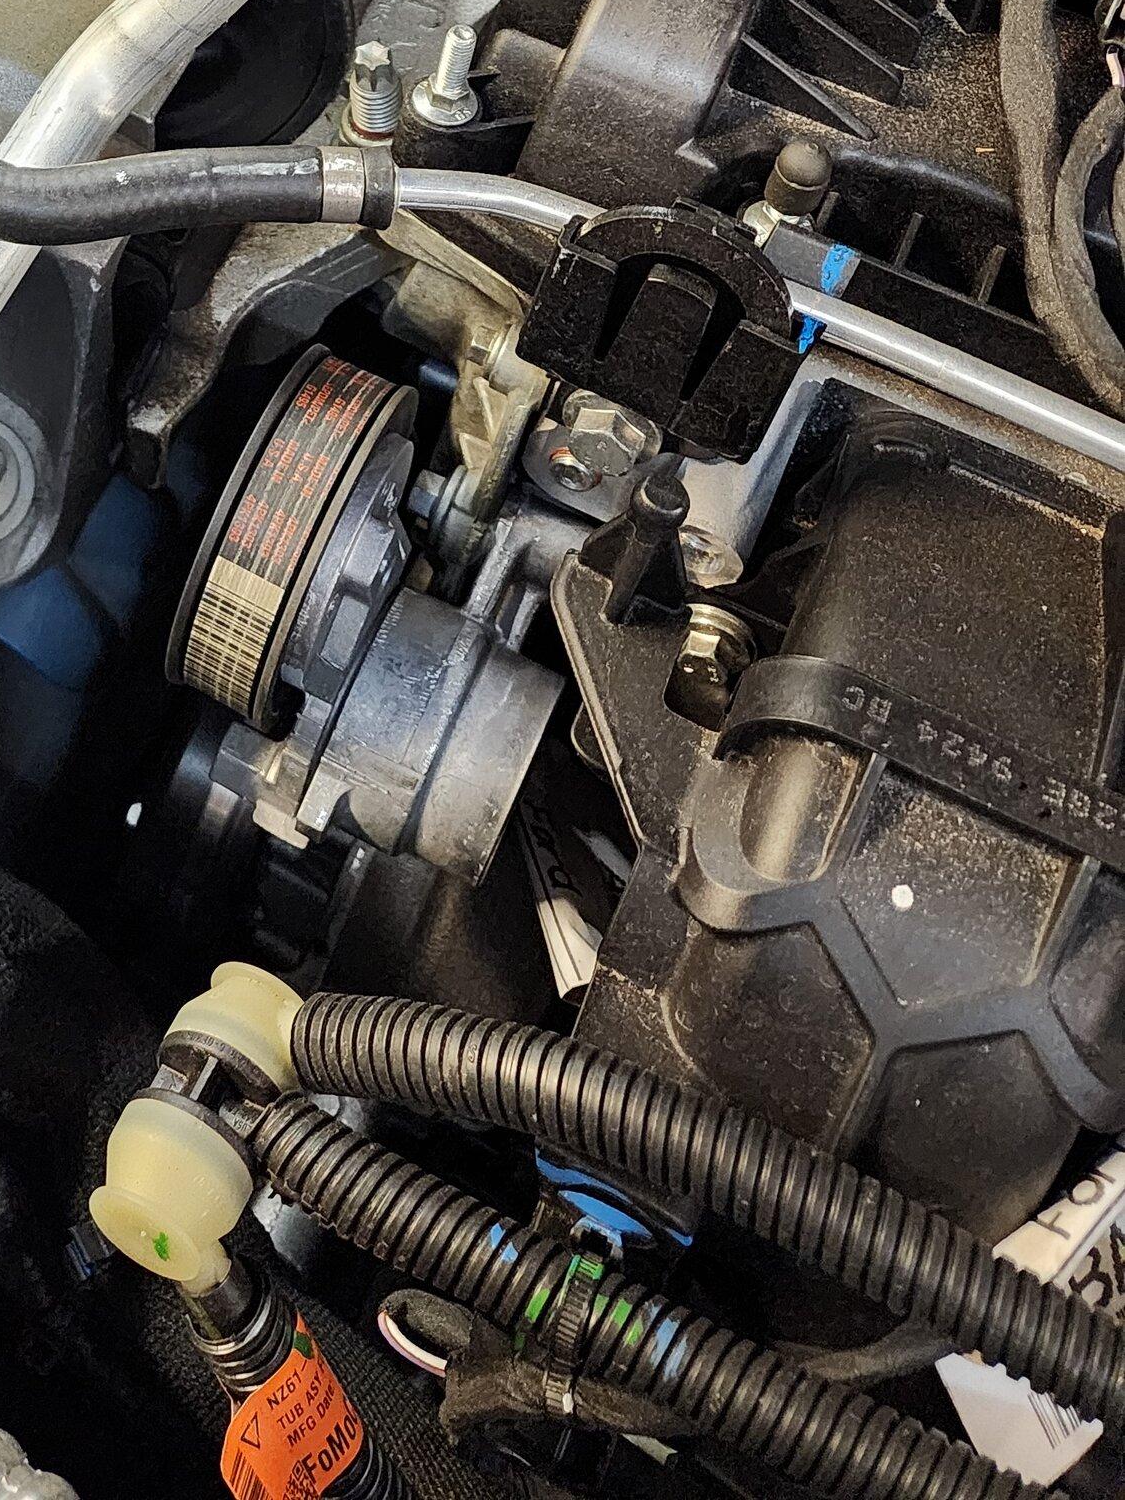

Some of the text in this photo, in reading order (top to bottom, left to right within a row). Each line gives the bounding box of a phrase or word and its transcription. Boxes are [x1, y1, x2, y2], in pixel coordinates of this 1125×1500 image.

[276, 1405, 304, 1430] TUB
[307, 1371, 324, 1406] ASY
[286, 1415, 317, 1448] MFG
